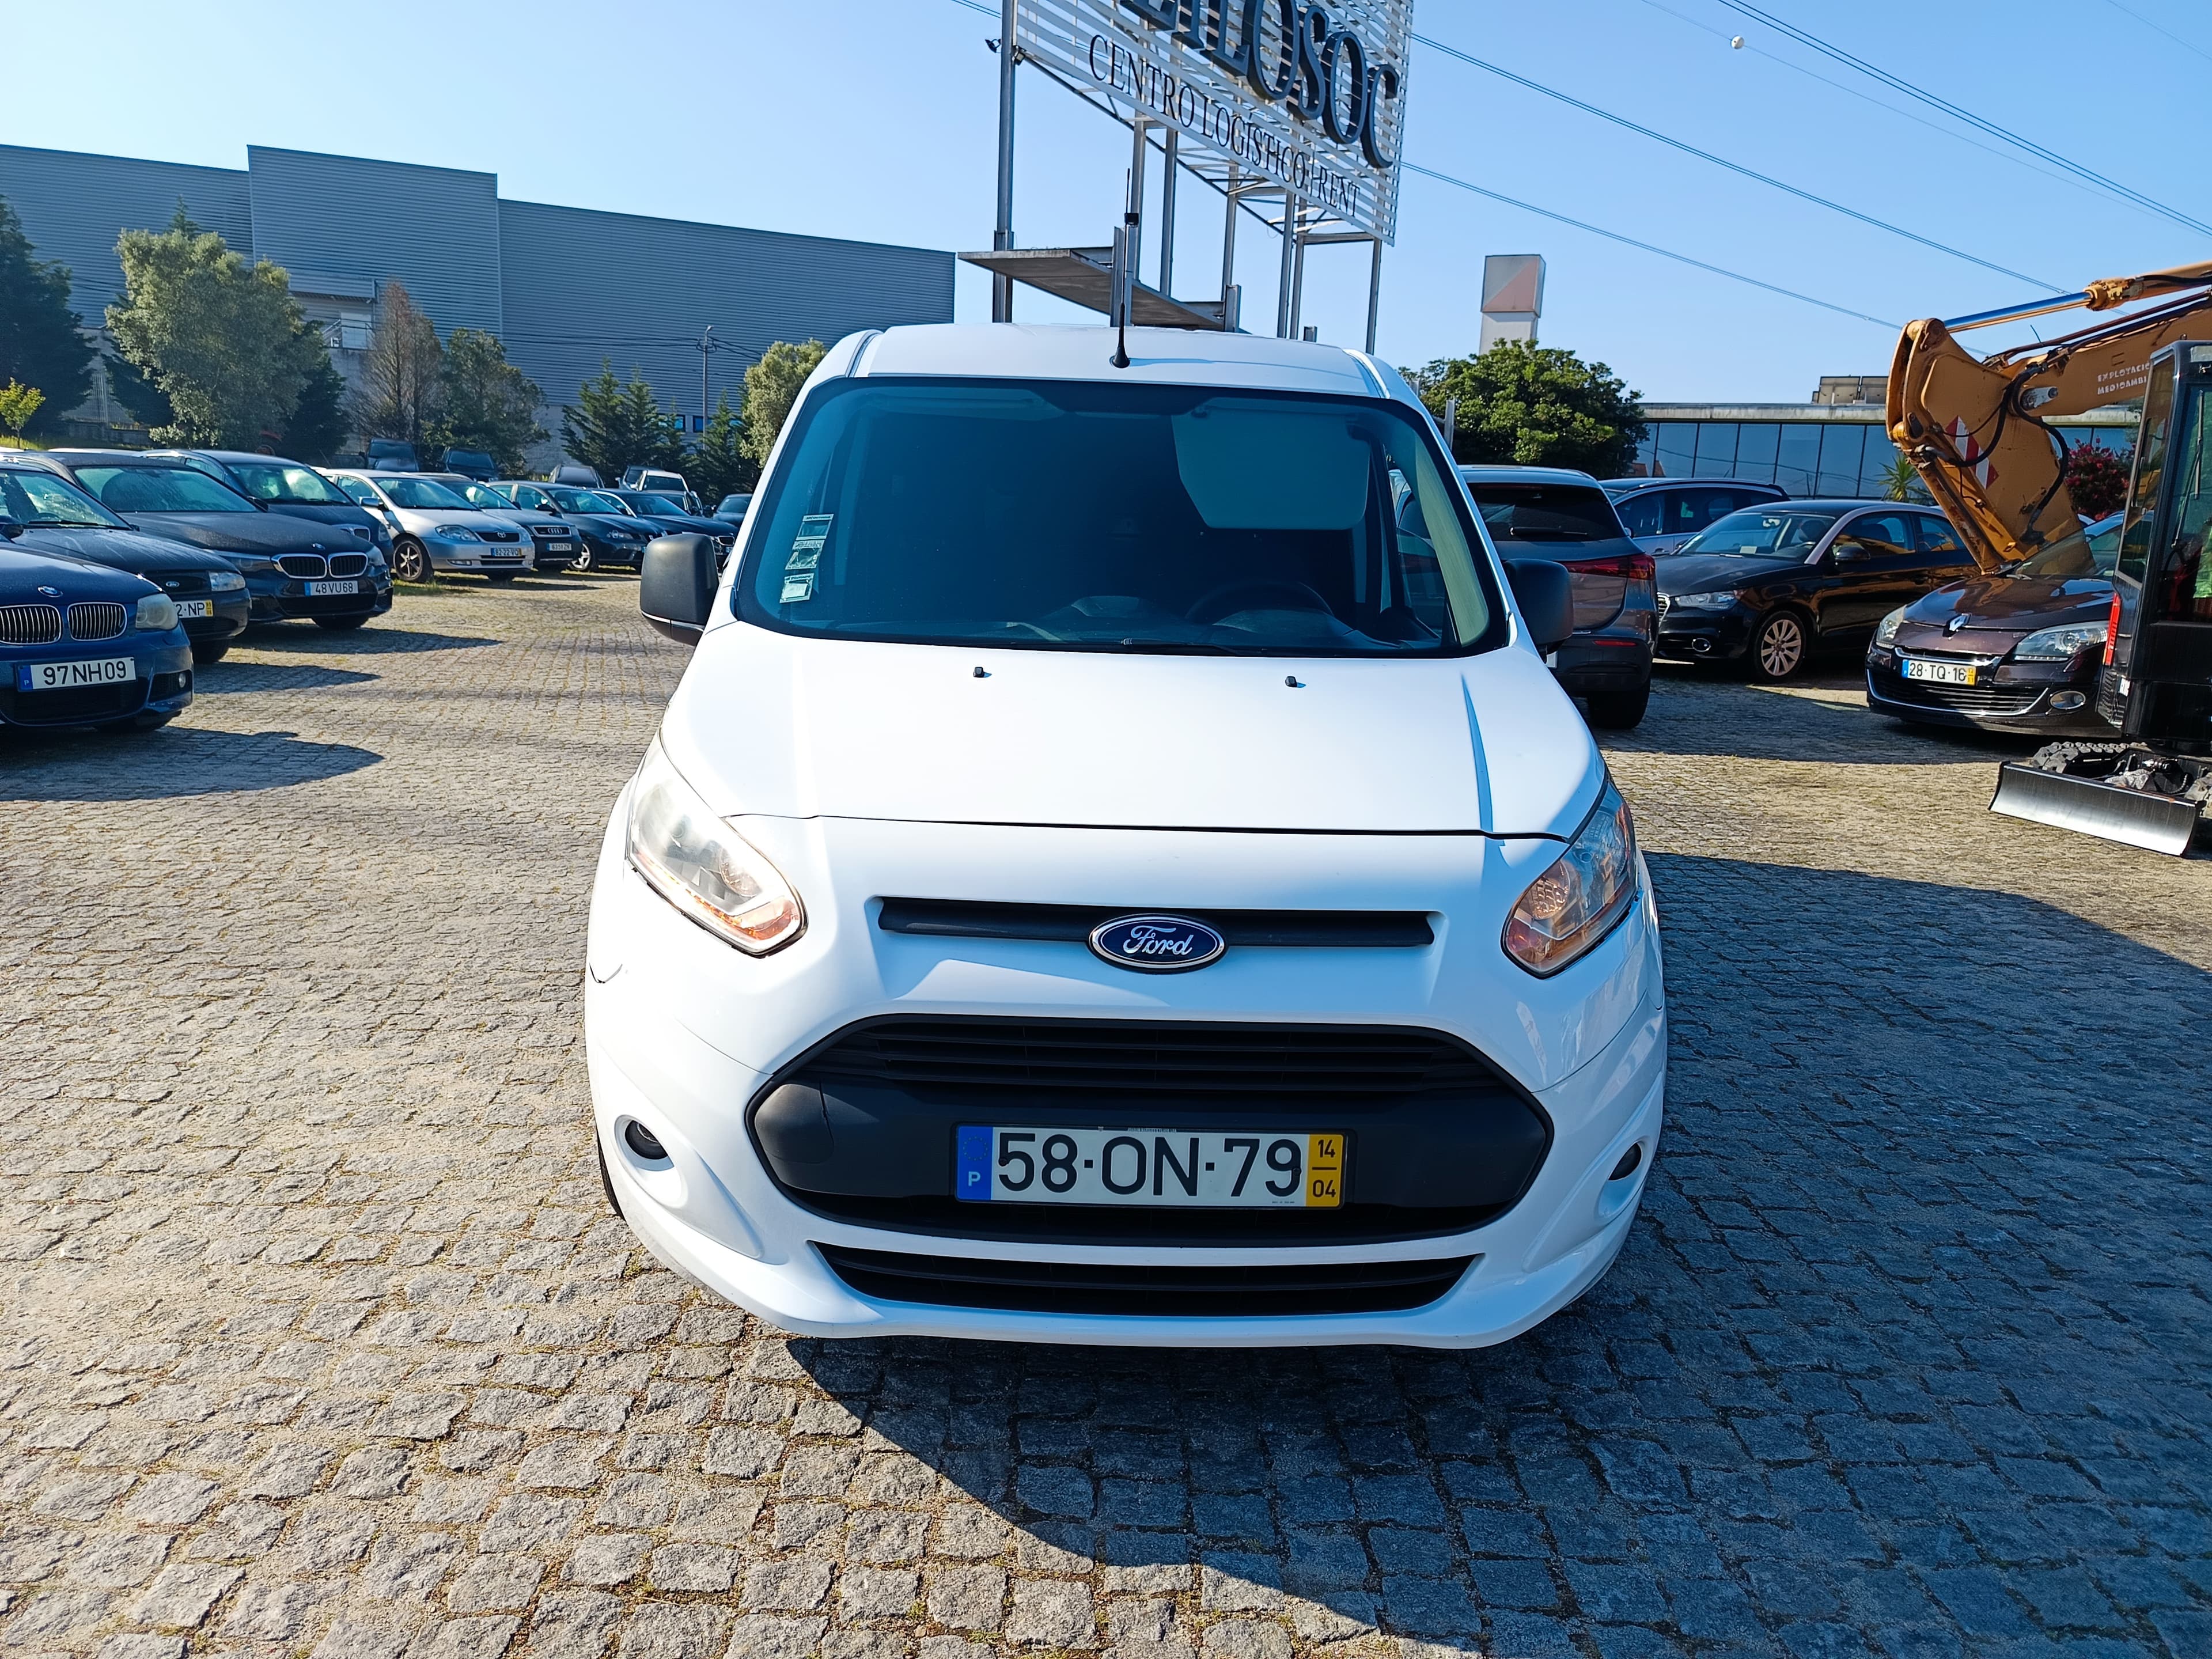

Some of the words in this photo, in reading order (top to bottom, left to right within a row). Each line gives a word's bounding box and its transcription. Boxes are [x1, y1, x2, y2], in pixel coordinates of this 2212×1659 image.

[1089, 35, 1195, 128] CENTRO
[1318, 165, 1360, 217] RENT
[315, 582, 353, 594] 48VU68
[43, 661, 126, 685] 97NH09
[1123, 925, 1194, 956] Ford
[1317, 1139, 1335, 1158] 14
[968, 1171, 981, 1187] P
[1312, 1179, 1336, 1198] 04
